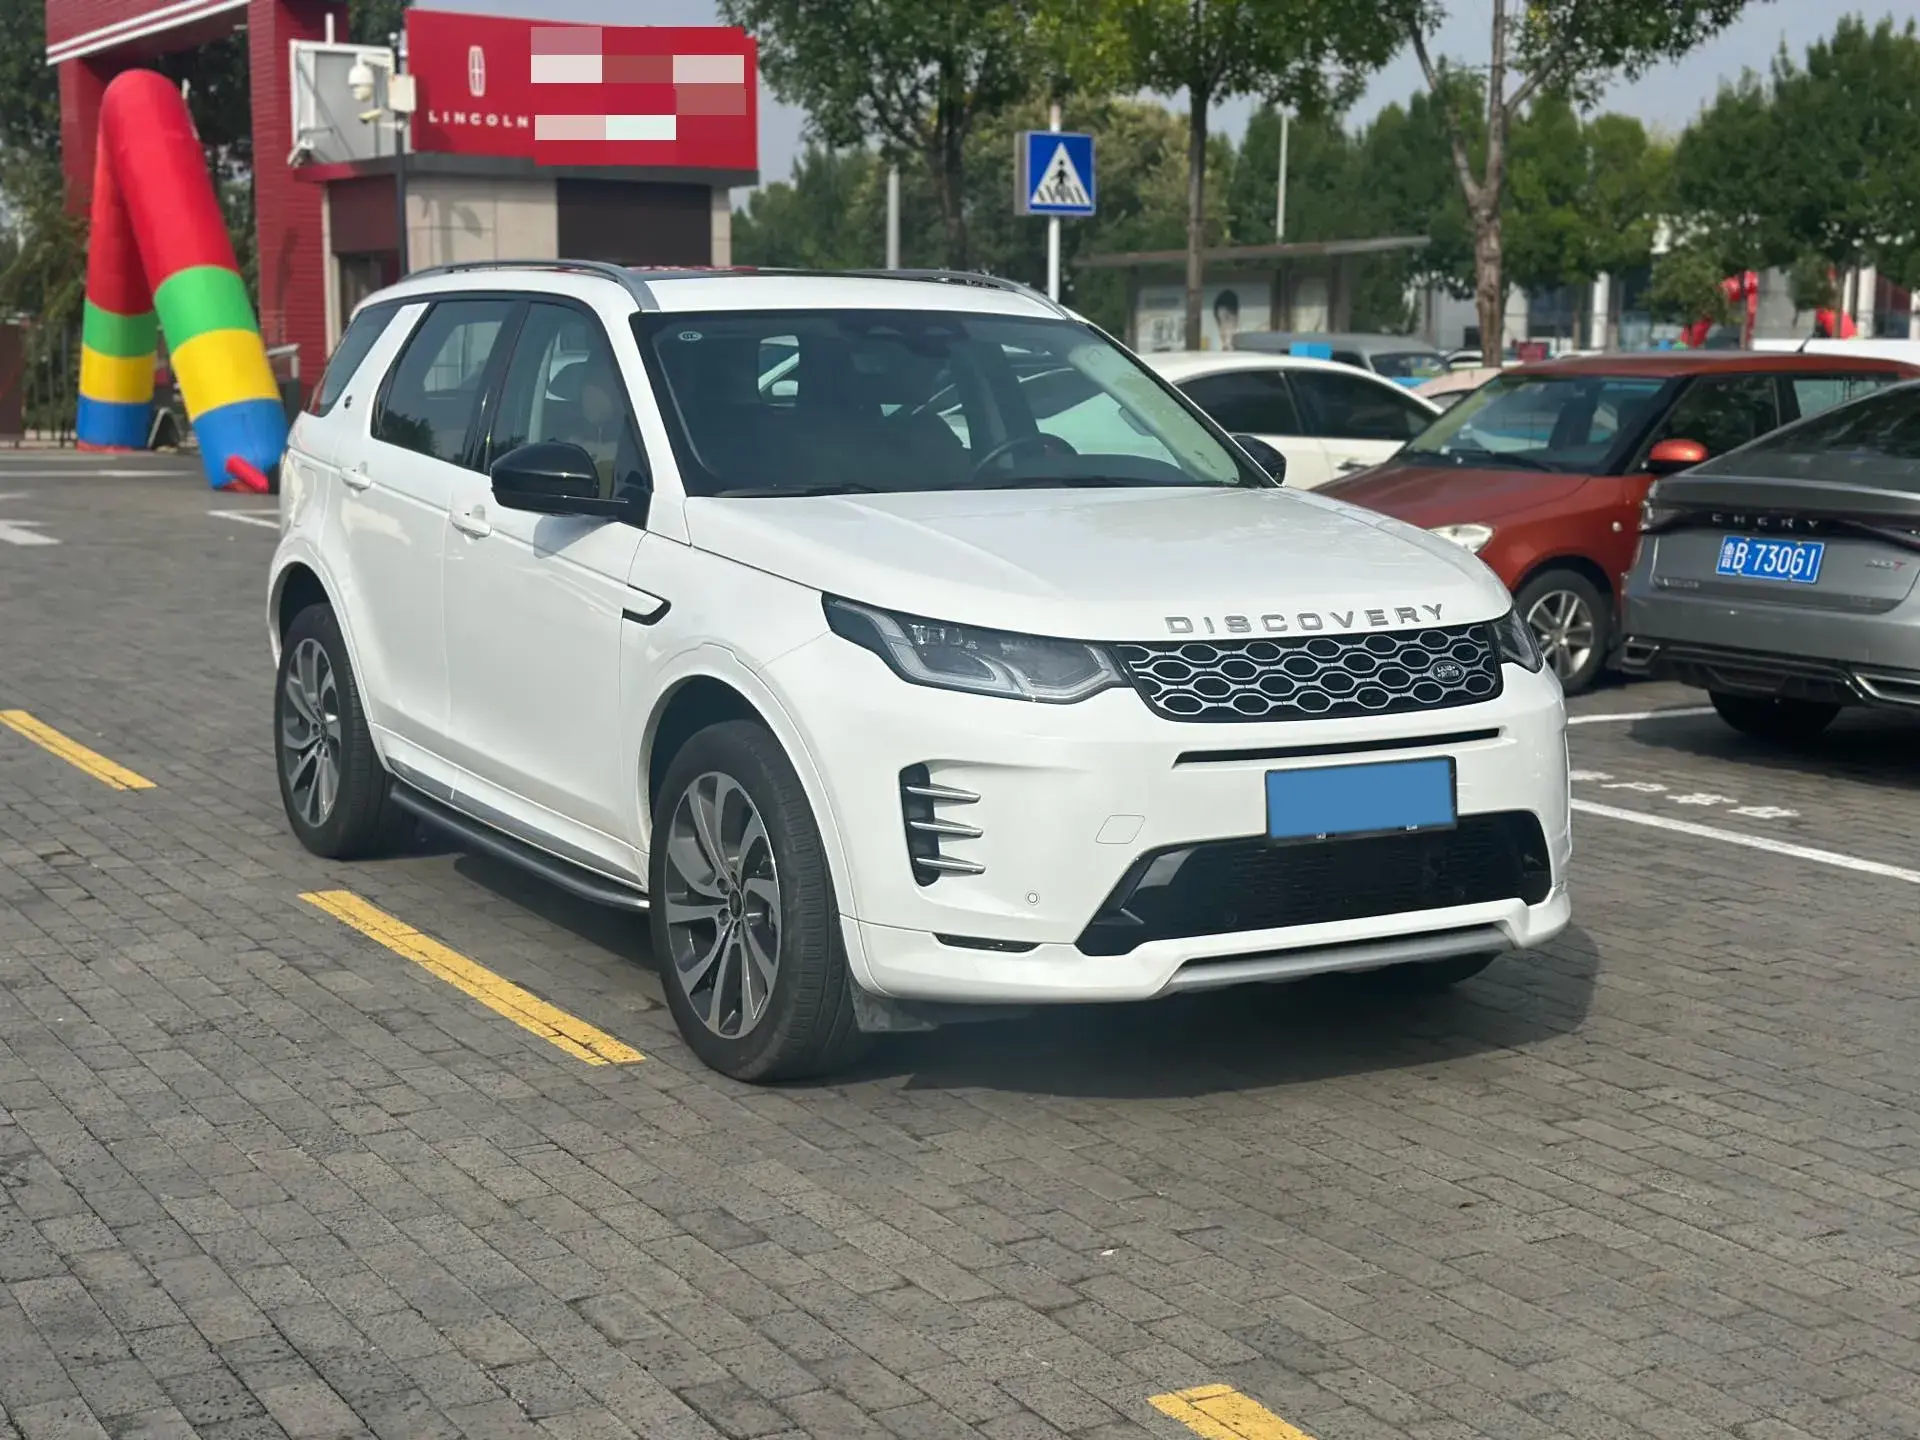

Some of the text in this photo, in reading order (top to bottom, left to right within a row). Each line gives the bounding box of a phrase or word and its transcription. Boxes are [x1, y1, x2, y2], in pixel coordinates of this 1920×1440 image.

[428, 110, 529, 128] LINCOLN
[1711, 513, 1818, 528] CHERY
[1165, 603, 1443, 634] DISCOVERY
